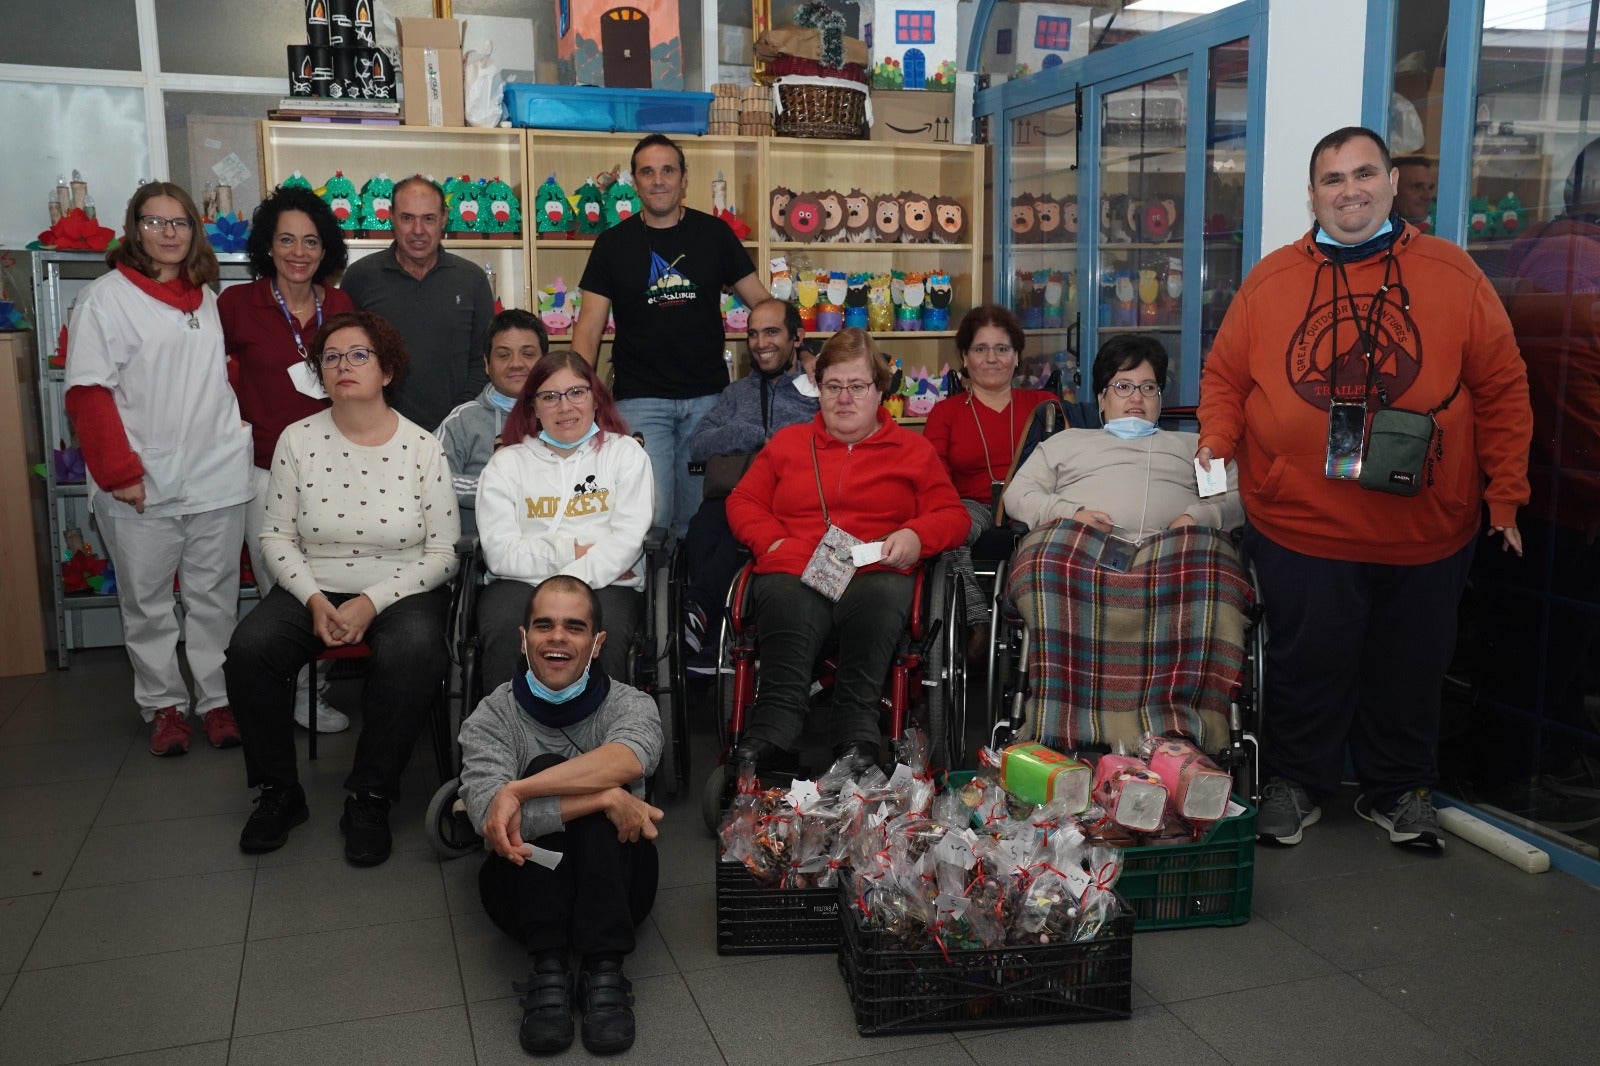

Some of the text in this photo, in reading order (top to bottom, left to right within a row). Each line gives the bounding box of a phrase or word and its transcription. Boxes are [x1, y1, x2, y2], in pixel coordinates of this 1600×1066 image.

[1307, 304, 1349, 337] OUTDOOR
[1355, 303, 1408, 343] ADENTURES
[1314, 384, 1380, 397] TRAILPLA
